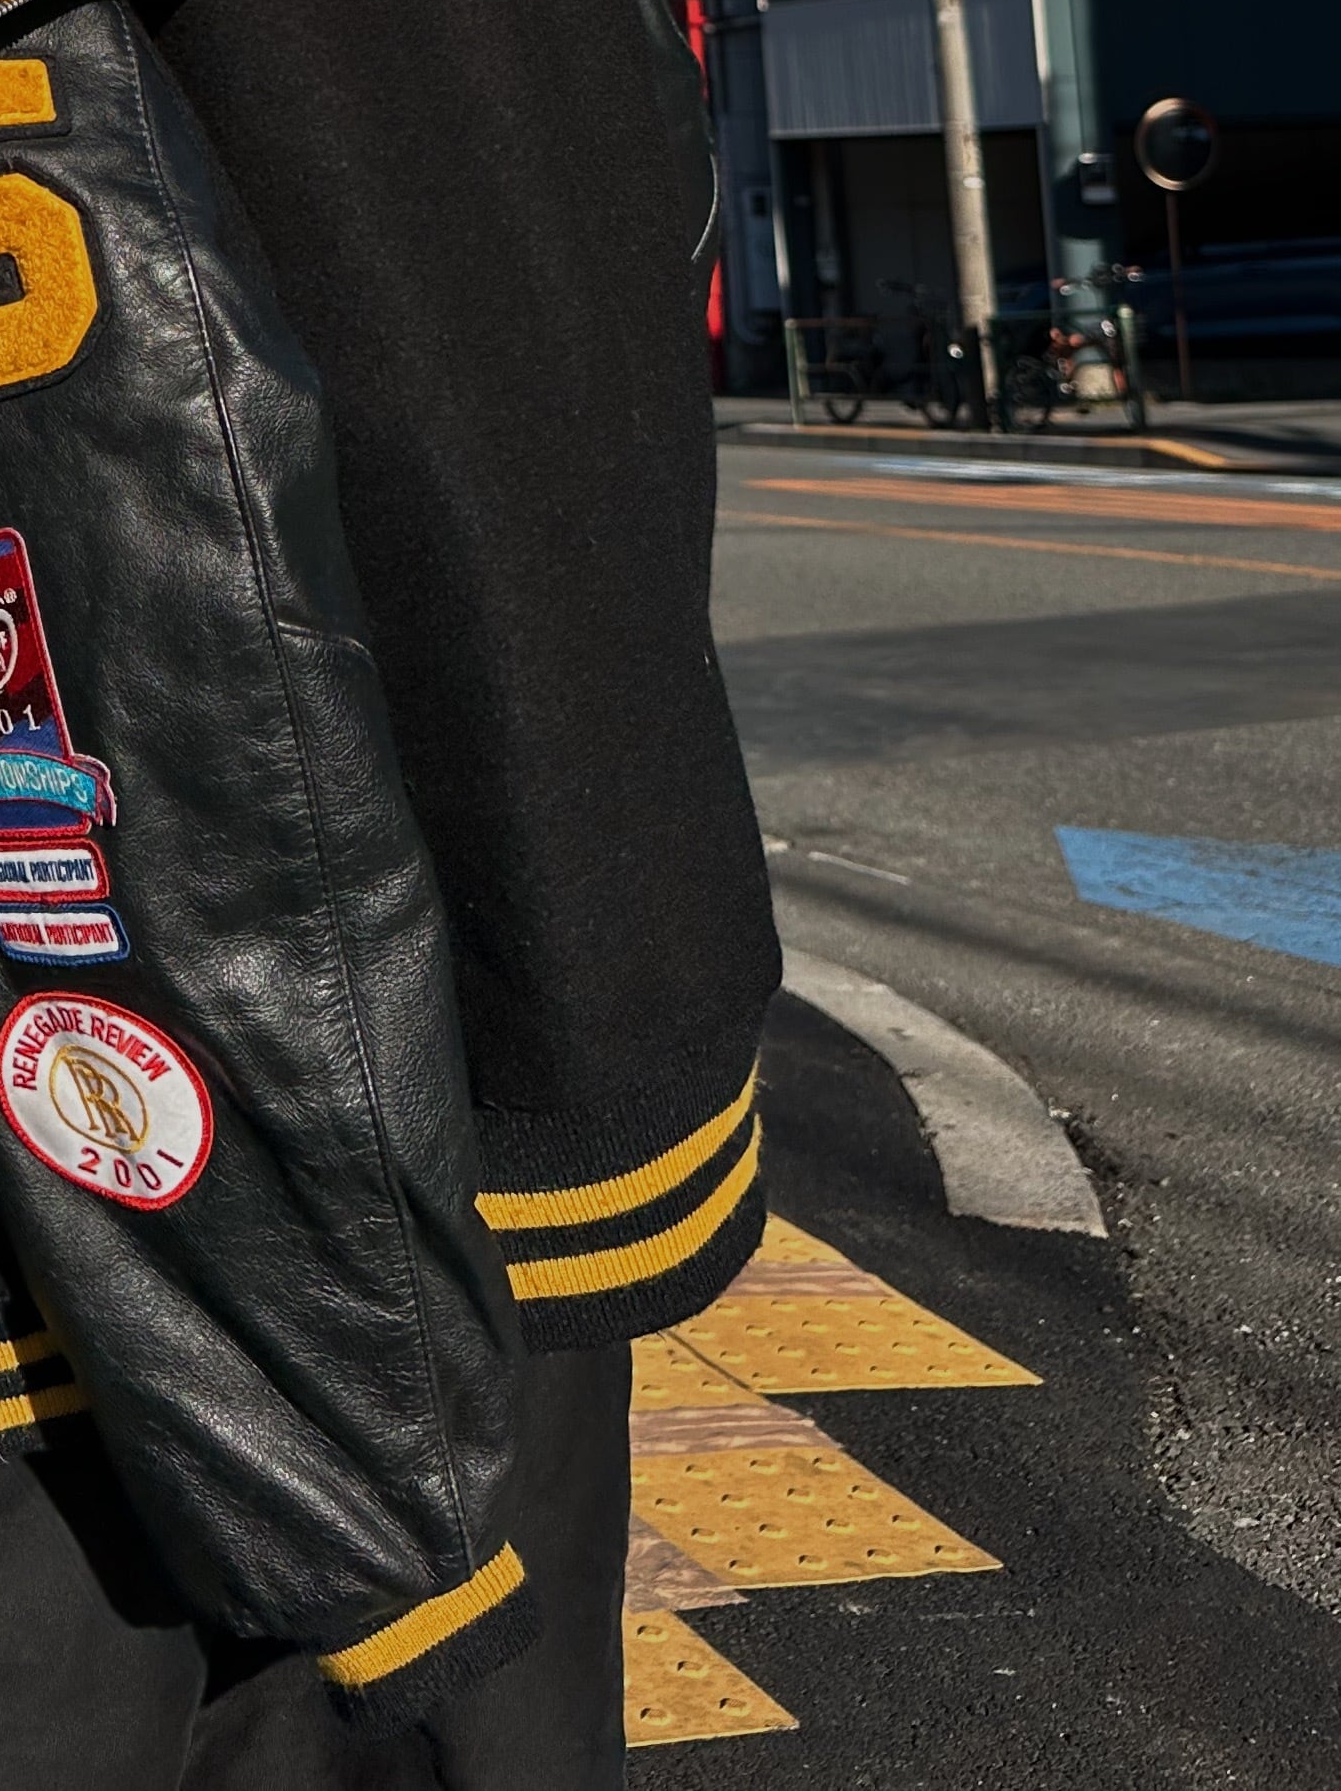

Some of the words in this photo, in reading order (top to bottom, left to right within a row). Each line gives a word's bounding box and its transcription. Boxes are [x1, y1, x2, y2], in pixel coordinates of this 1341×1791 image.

[29, 858, 95, 883] PARTICIPANT
[44, 921, 115, 946] PARTICIPANT
[12, 1006, 87, 1091] RENEGADE
[90, 1013, 172, 1082] REVIEW
[78, 1147, 184, 1191] 2001
